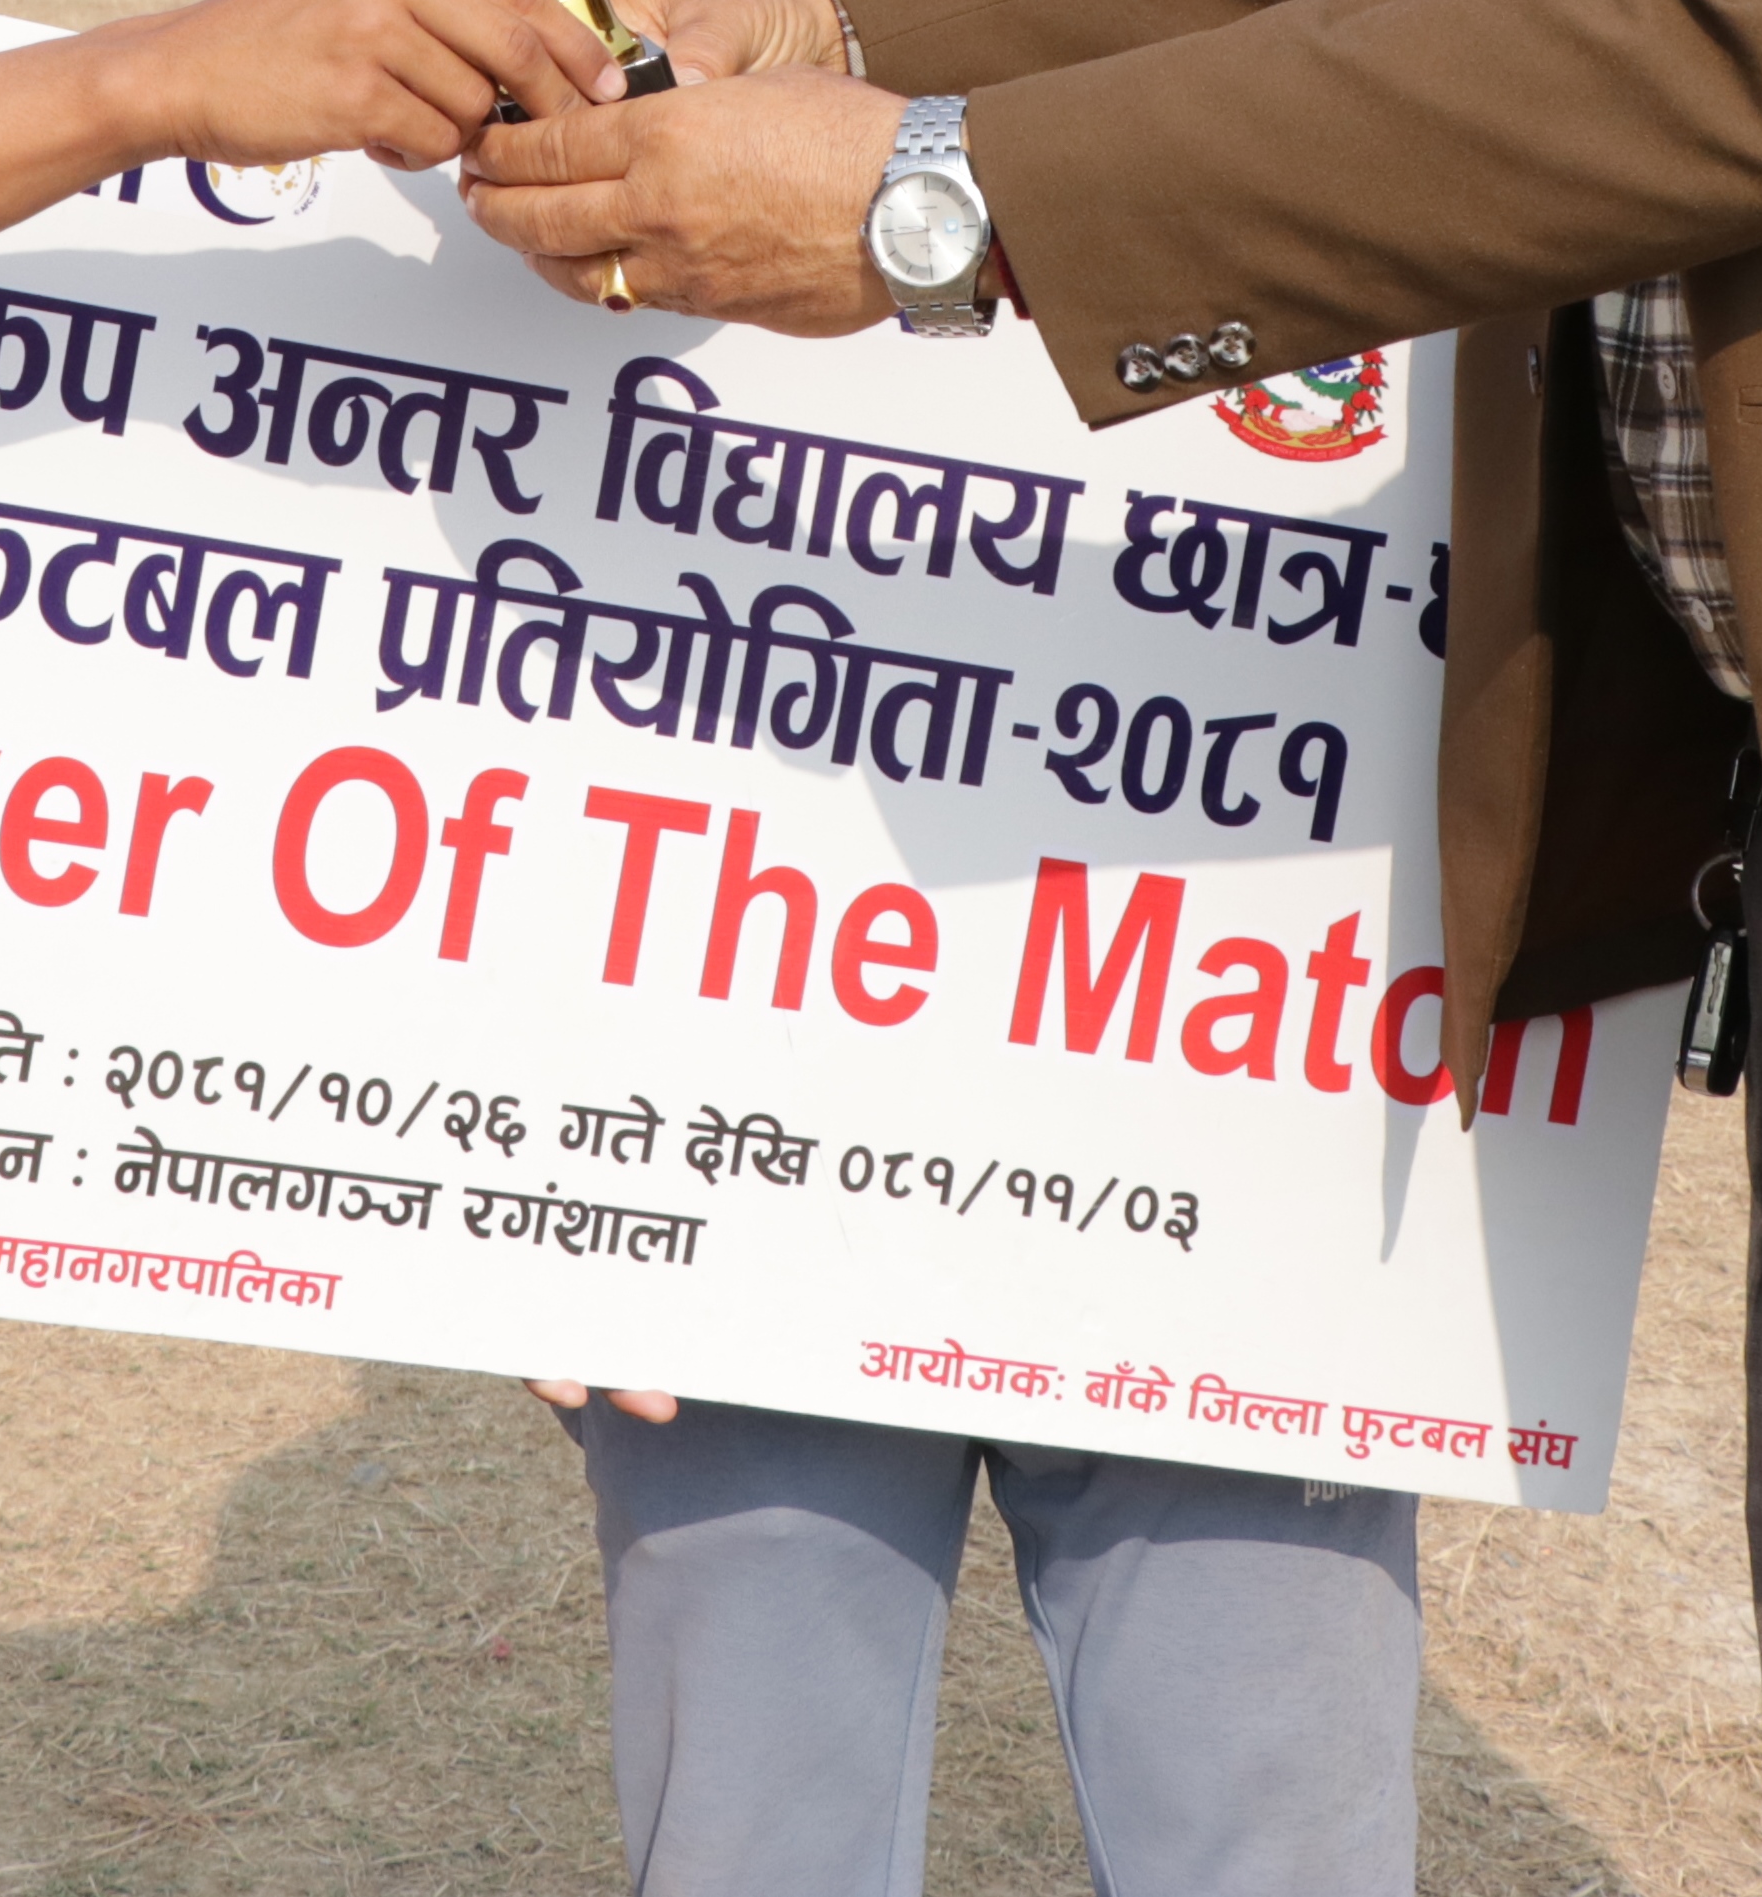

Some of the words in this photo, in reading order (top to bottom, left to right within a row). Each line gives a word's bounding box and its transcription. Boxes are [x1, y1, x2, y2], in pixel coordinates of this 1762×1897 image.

[182, 324, 569, 515] अन्तर
[594, 357, 1085, 596] विद्यालय
[375, 538, 1348, 843] प्रतियोगिता-२०८१
[273, 746, 529, 962] Of
[584, 786, 938, 1026] The
[106, 1046, 526, 1158] २०८१/१०/२६
[560, 1095, 665, 1164] गते
[686, 1105, 819, 1185] देखि
[840, 1146, 1198, 1252] ०८१/११/०३
[115, 1125, 442, 1230] नेपालगञ्ज
[1086, 1362, 1175, 1413] बाँके
[1189, 1374, 1328, 1435] जिल्ला
[1343, 1406, 1492, 1459] फुटबल
[1508, 1419, 1580, 1470] संघ
